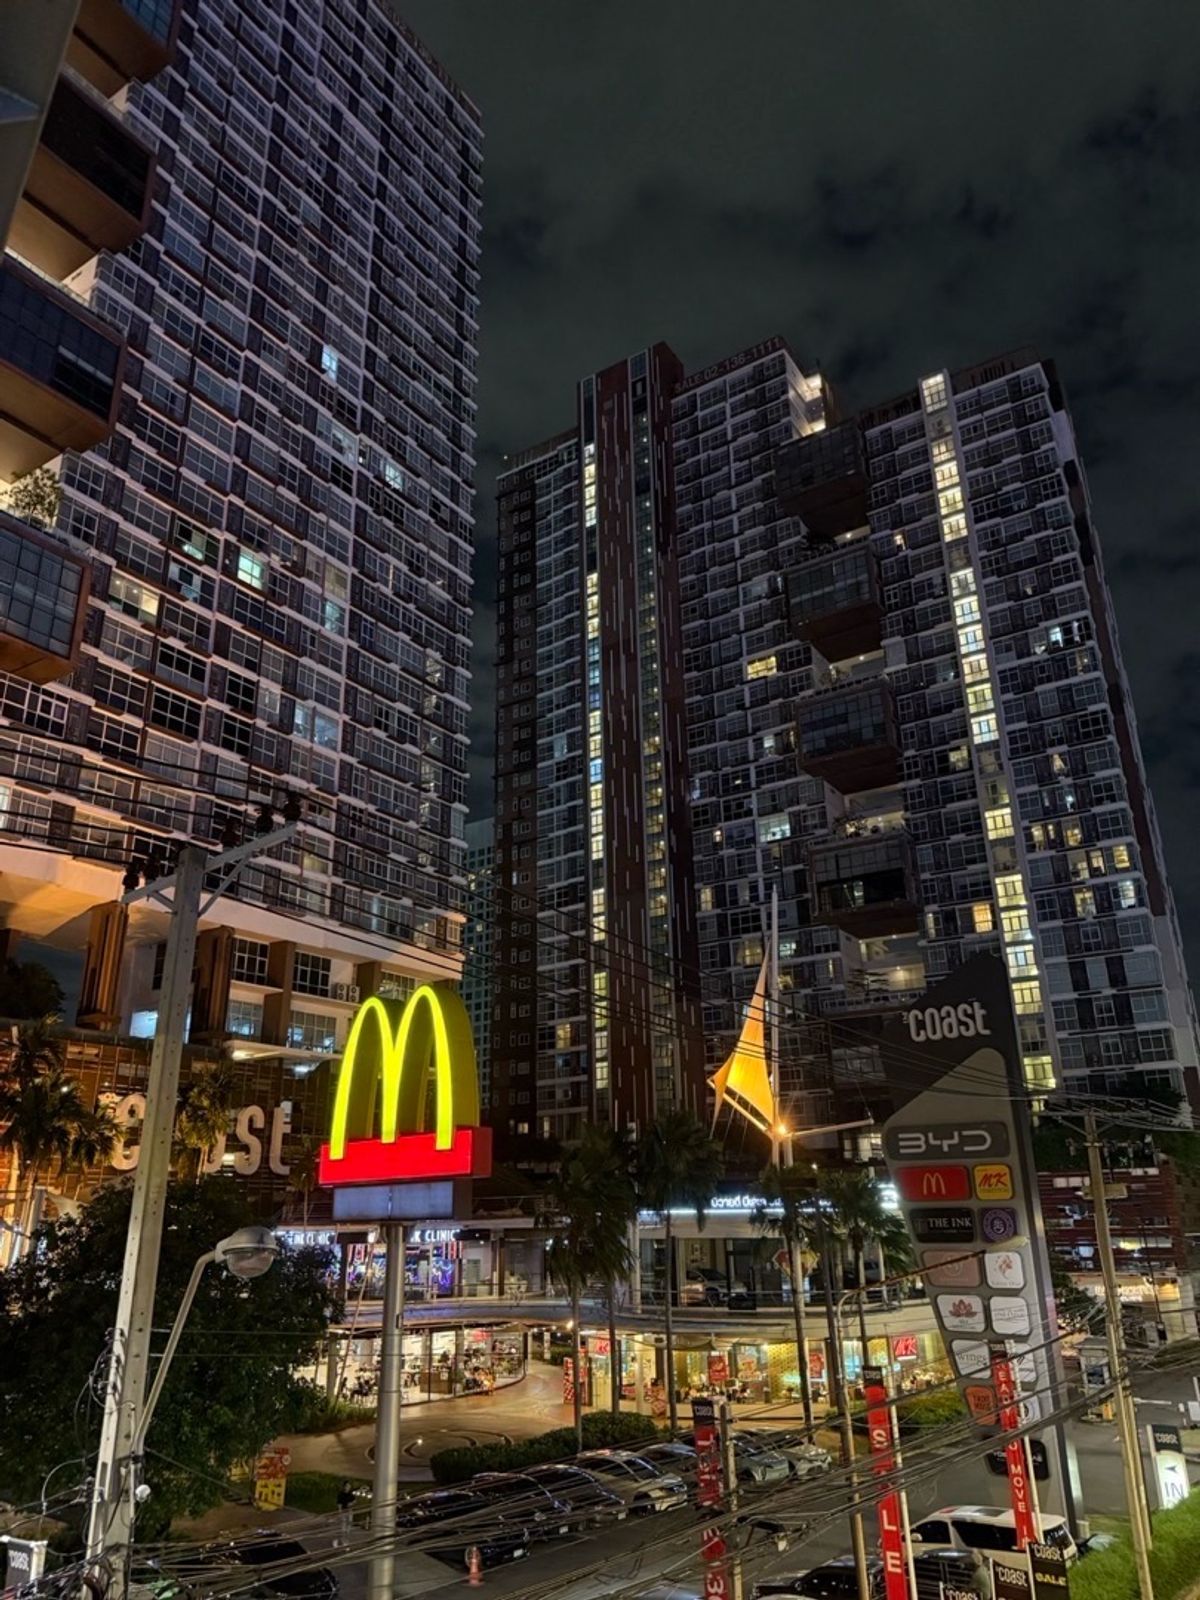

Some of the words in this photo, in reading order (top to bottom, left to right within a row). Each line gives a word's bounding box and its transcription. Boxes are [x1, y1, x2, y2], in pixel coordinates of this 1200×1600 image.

[909, 1002, 992, 1042] coast
[898, 1130, 992, 1153] BYD
[978, 1172, 1007, 1188] MK
[928, 1218, 950, 1228] THE
[952, 1217, 972, 1228] INK
[425, 1228, 457, 1243] CLINIC
[1011, 1463, 1027, 1513] MOVE
[1164, 1481, 1185, 1500] IN
